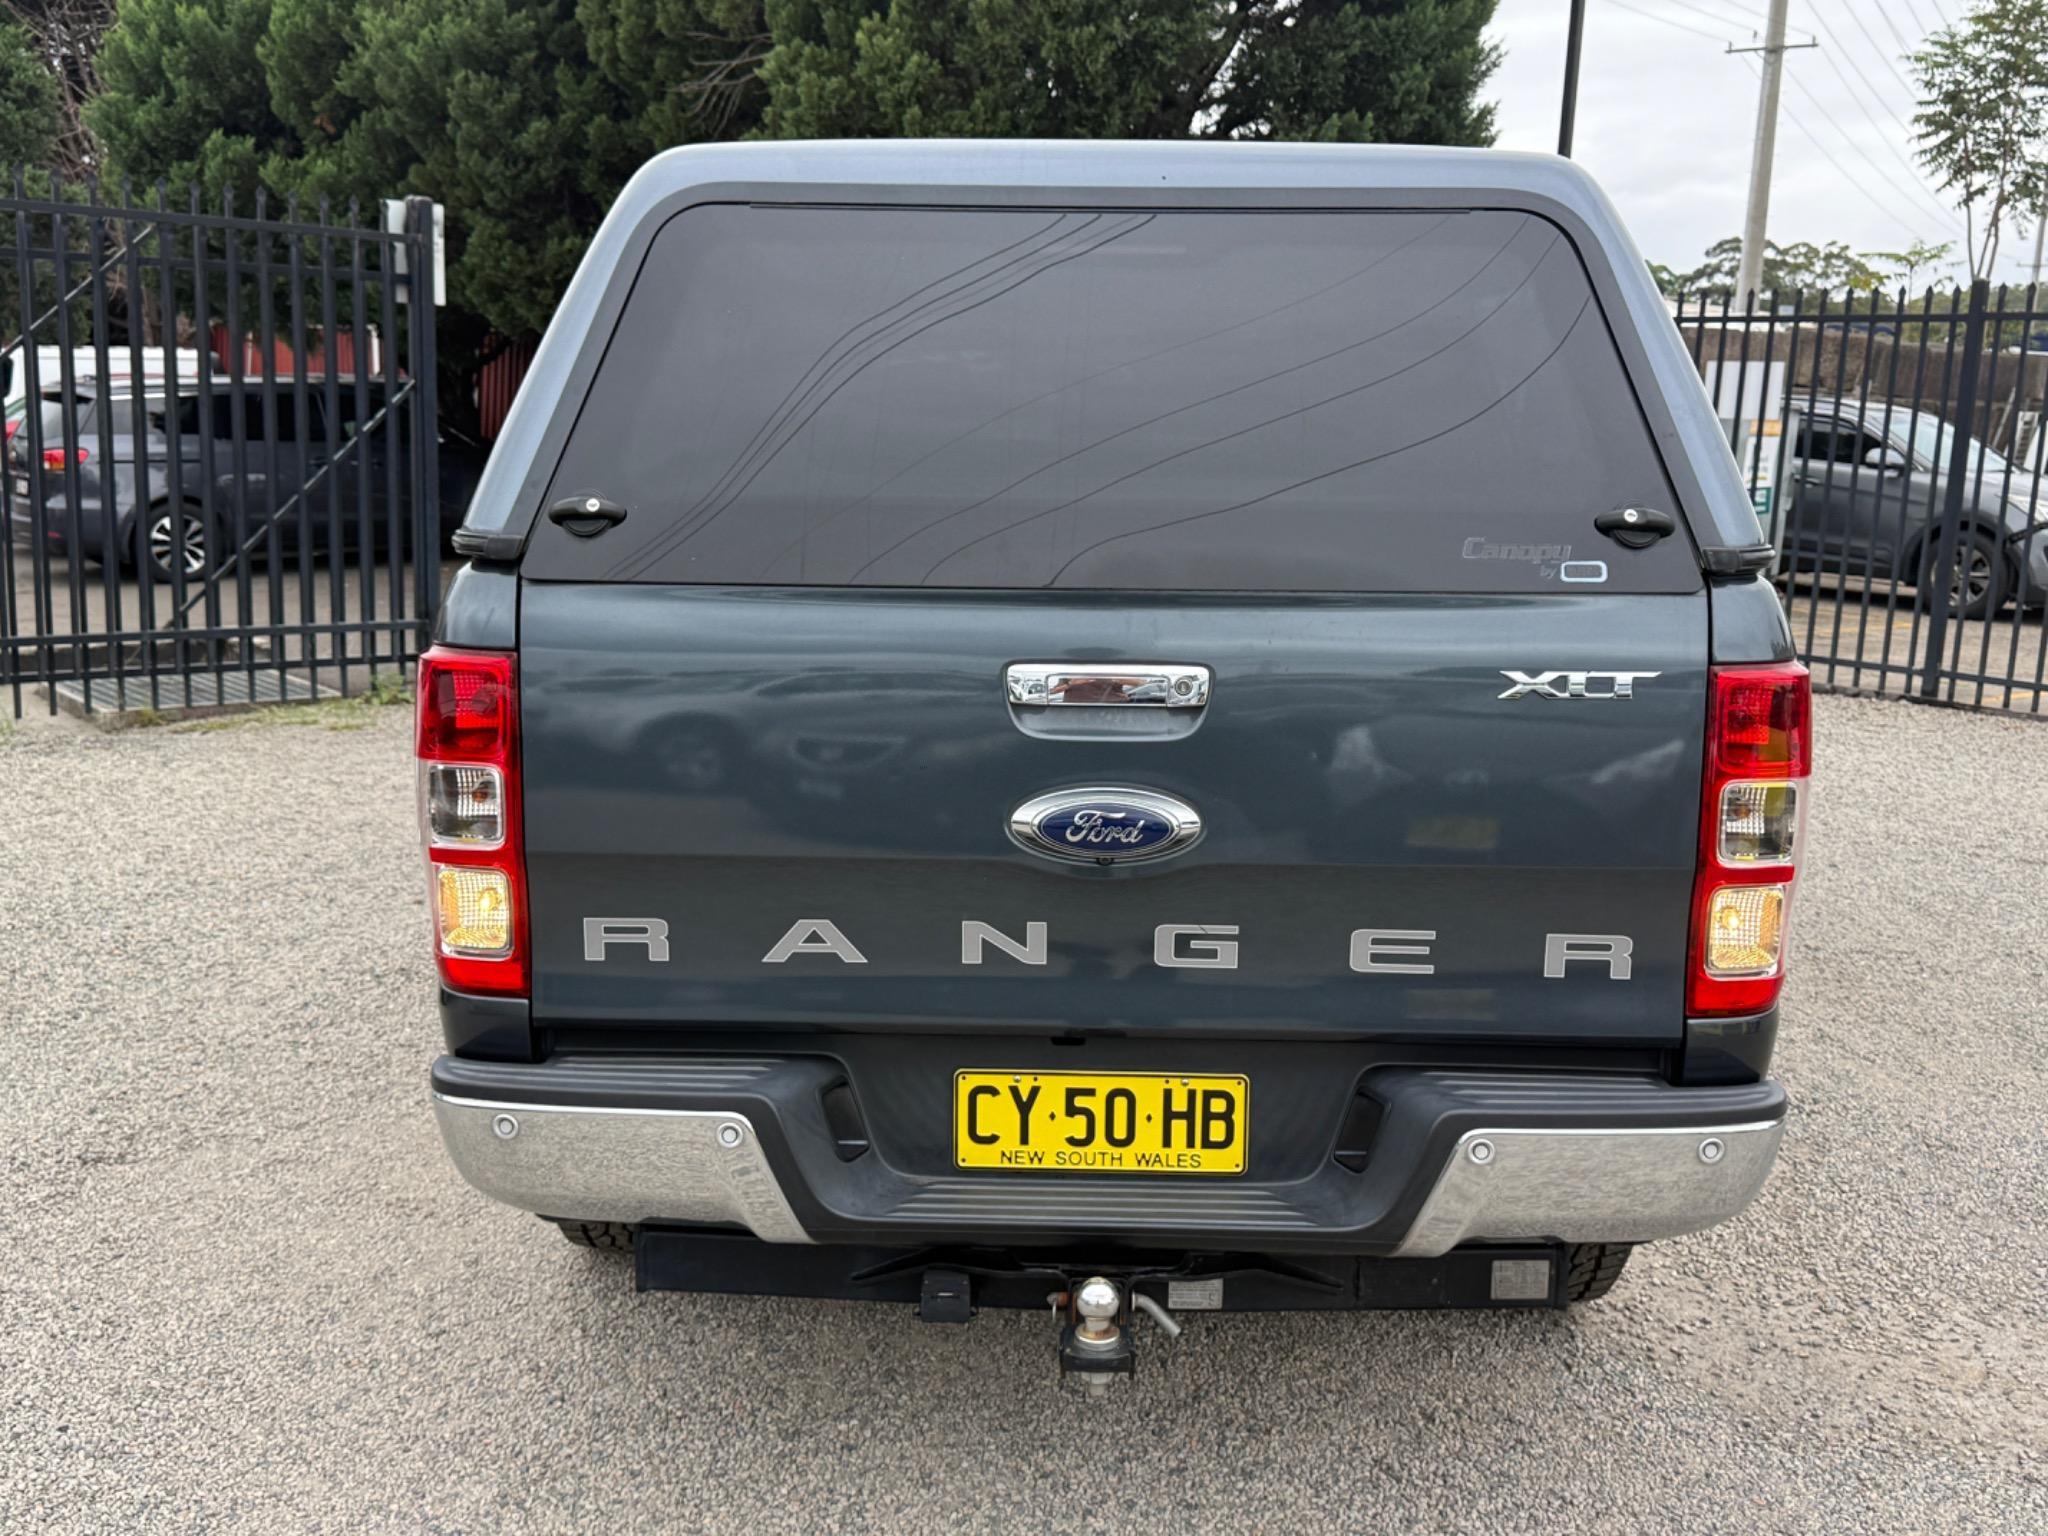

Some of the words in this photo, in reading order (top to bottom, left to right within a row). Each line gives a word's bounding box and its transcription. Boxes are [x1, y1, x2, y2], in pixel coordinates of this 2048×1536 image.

[1462, 536, 1573, 564] Canopy
[1540, 565, 1557, 580] by
[1497, 670, 1662, 699] XLT
[1065, 809, 1145, 843] Ford
[583, 917, 1633, 979] RANGER
[1000, 1150, 1045, 1165] NEW
[1055, 1151, 1123, 1167] SOUTH
[1135, 1153, 1201, 1168] WALES
